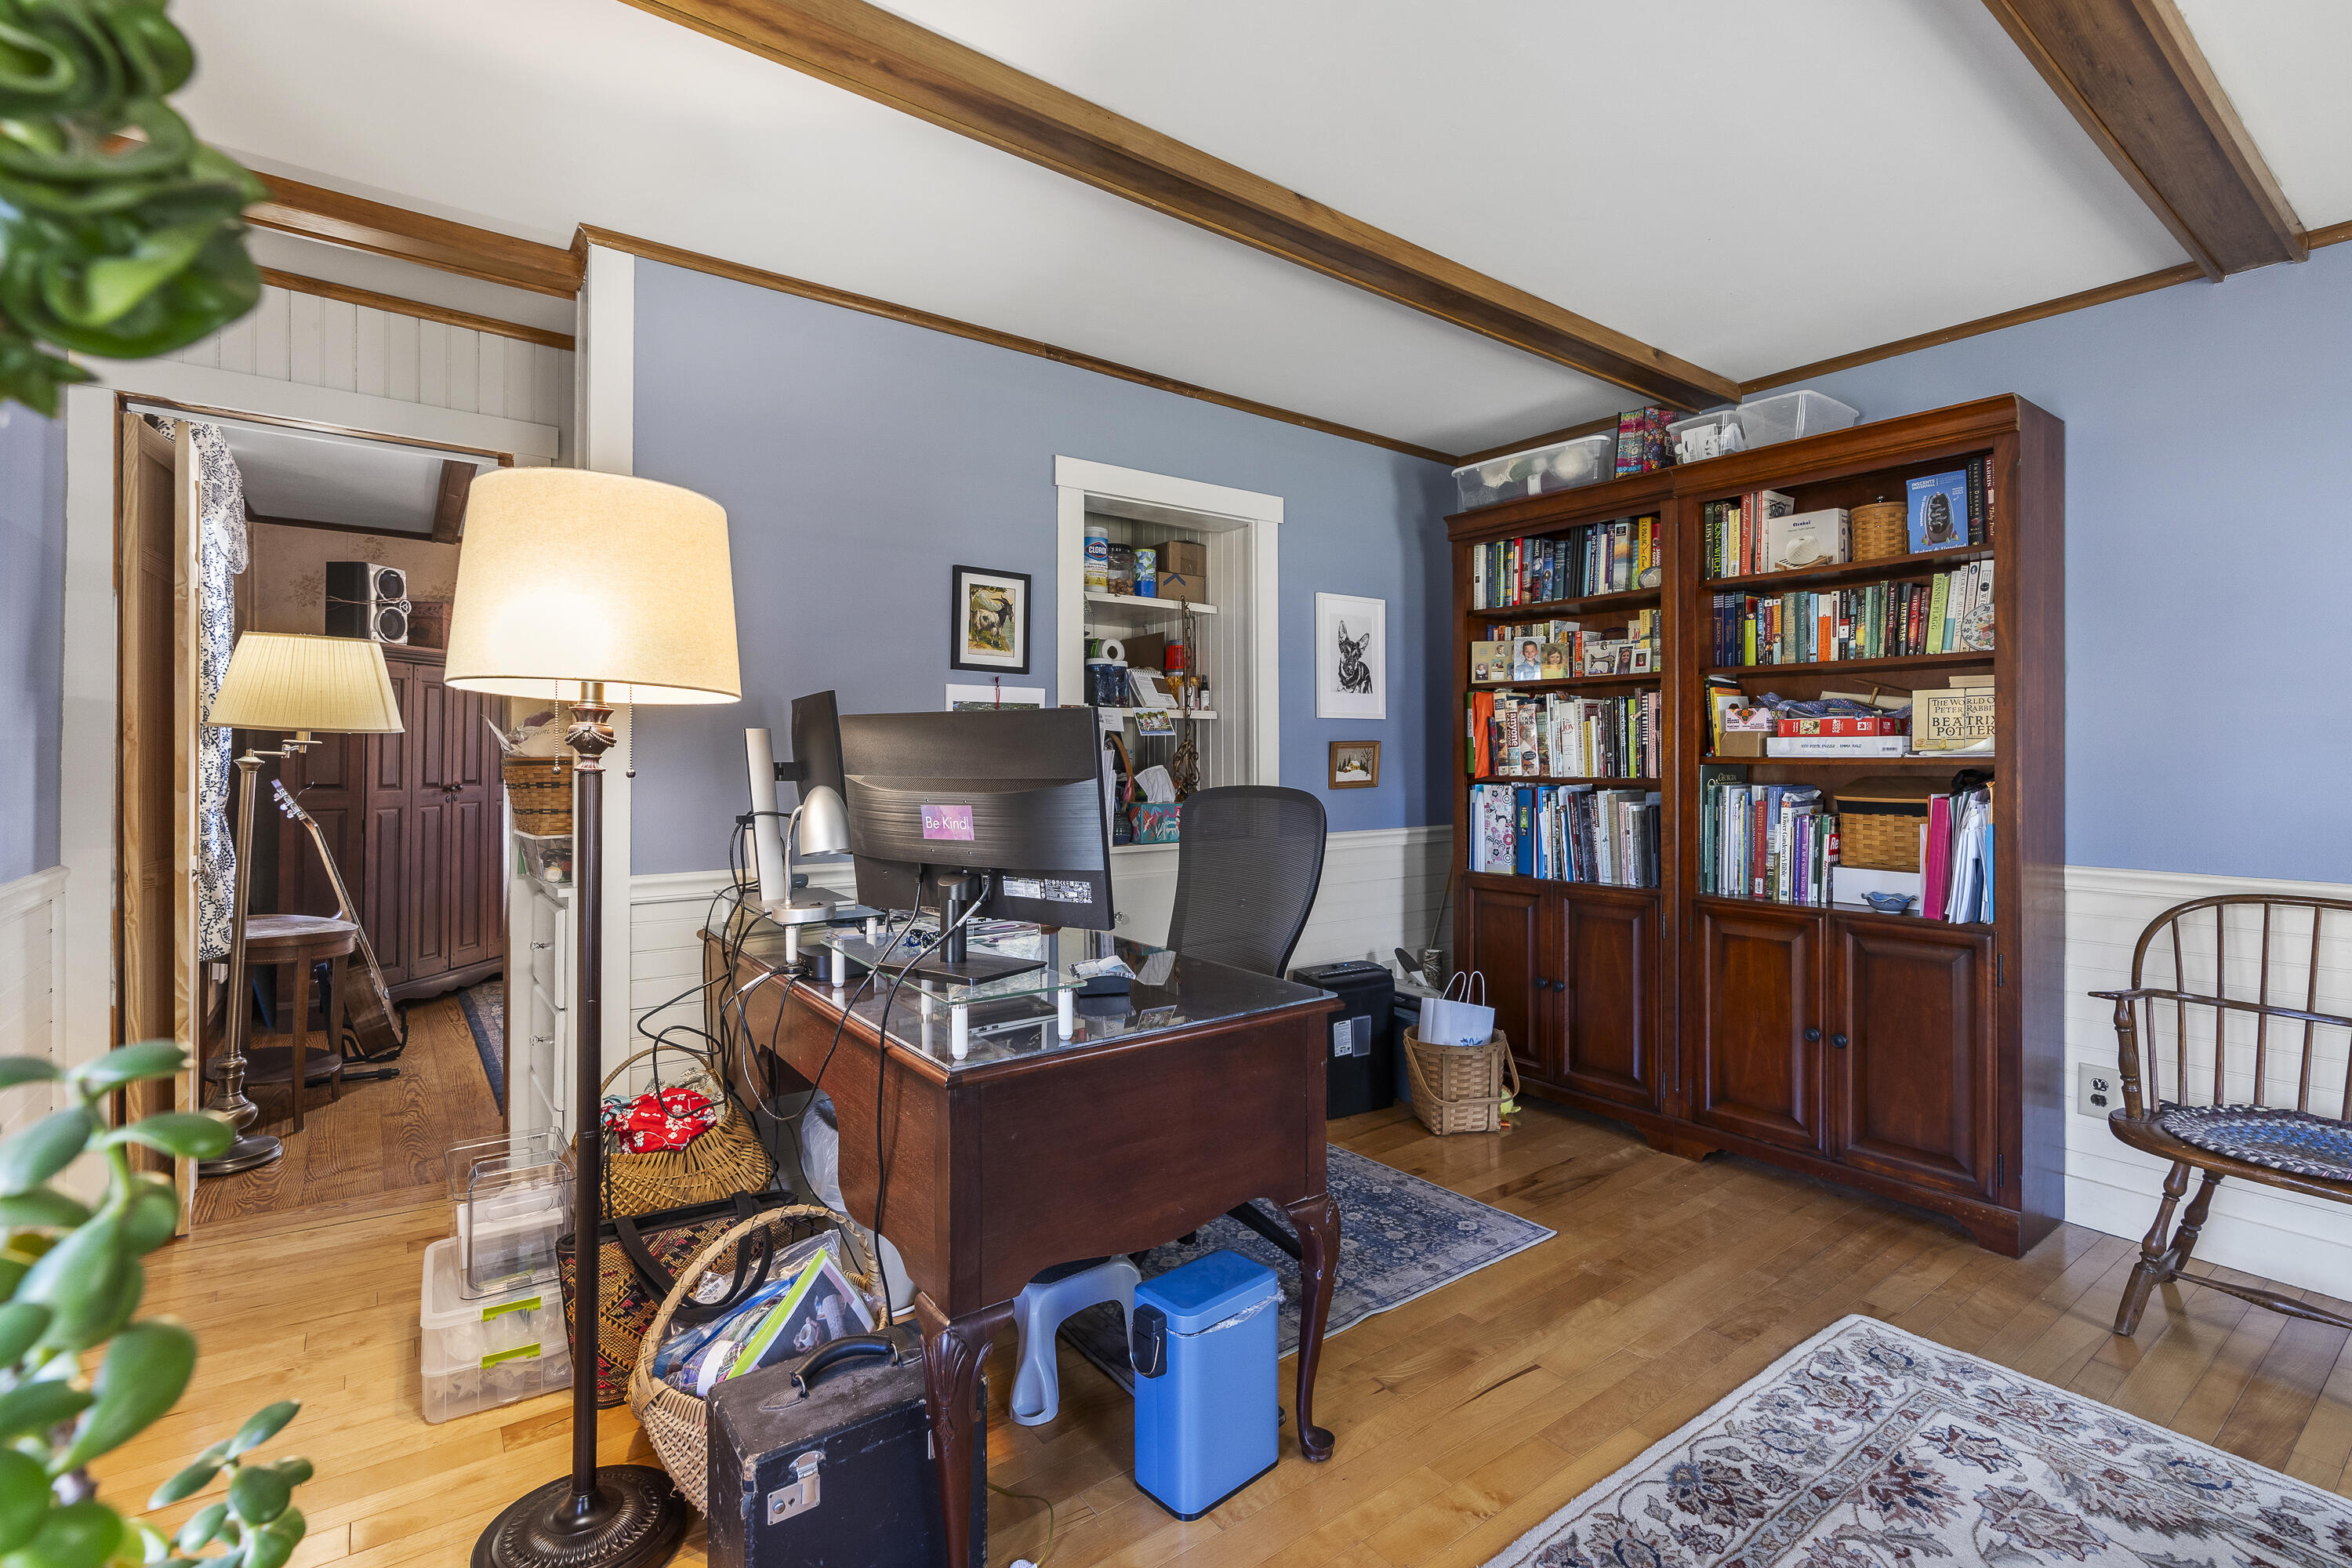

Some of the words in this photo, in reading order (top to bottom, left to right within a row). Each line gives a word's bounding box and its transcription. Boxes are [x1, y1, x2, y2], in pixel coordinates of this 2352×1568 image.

[1741, 495, 1750, 536] Swamplandia!
[1955, 601, 1963, 637] QUARANTINE
[1508, 713, 1518, 746] anyone
[1562, 720, 1573, 733] Joy
[1937, 726, 1994, 735] POTTER
[925, 816, 939, 829] Be
[1830, 837, 1839, 851] Re
